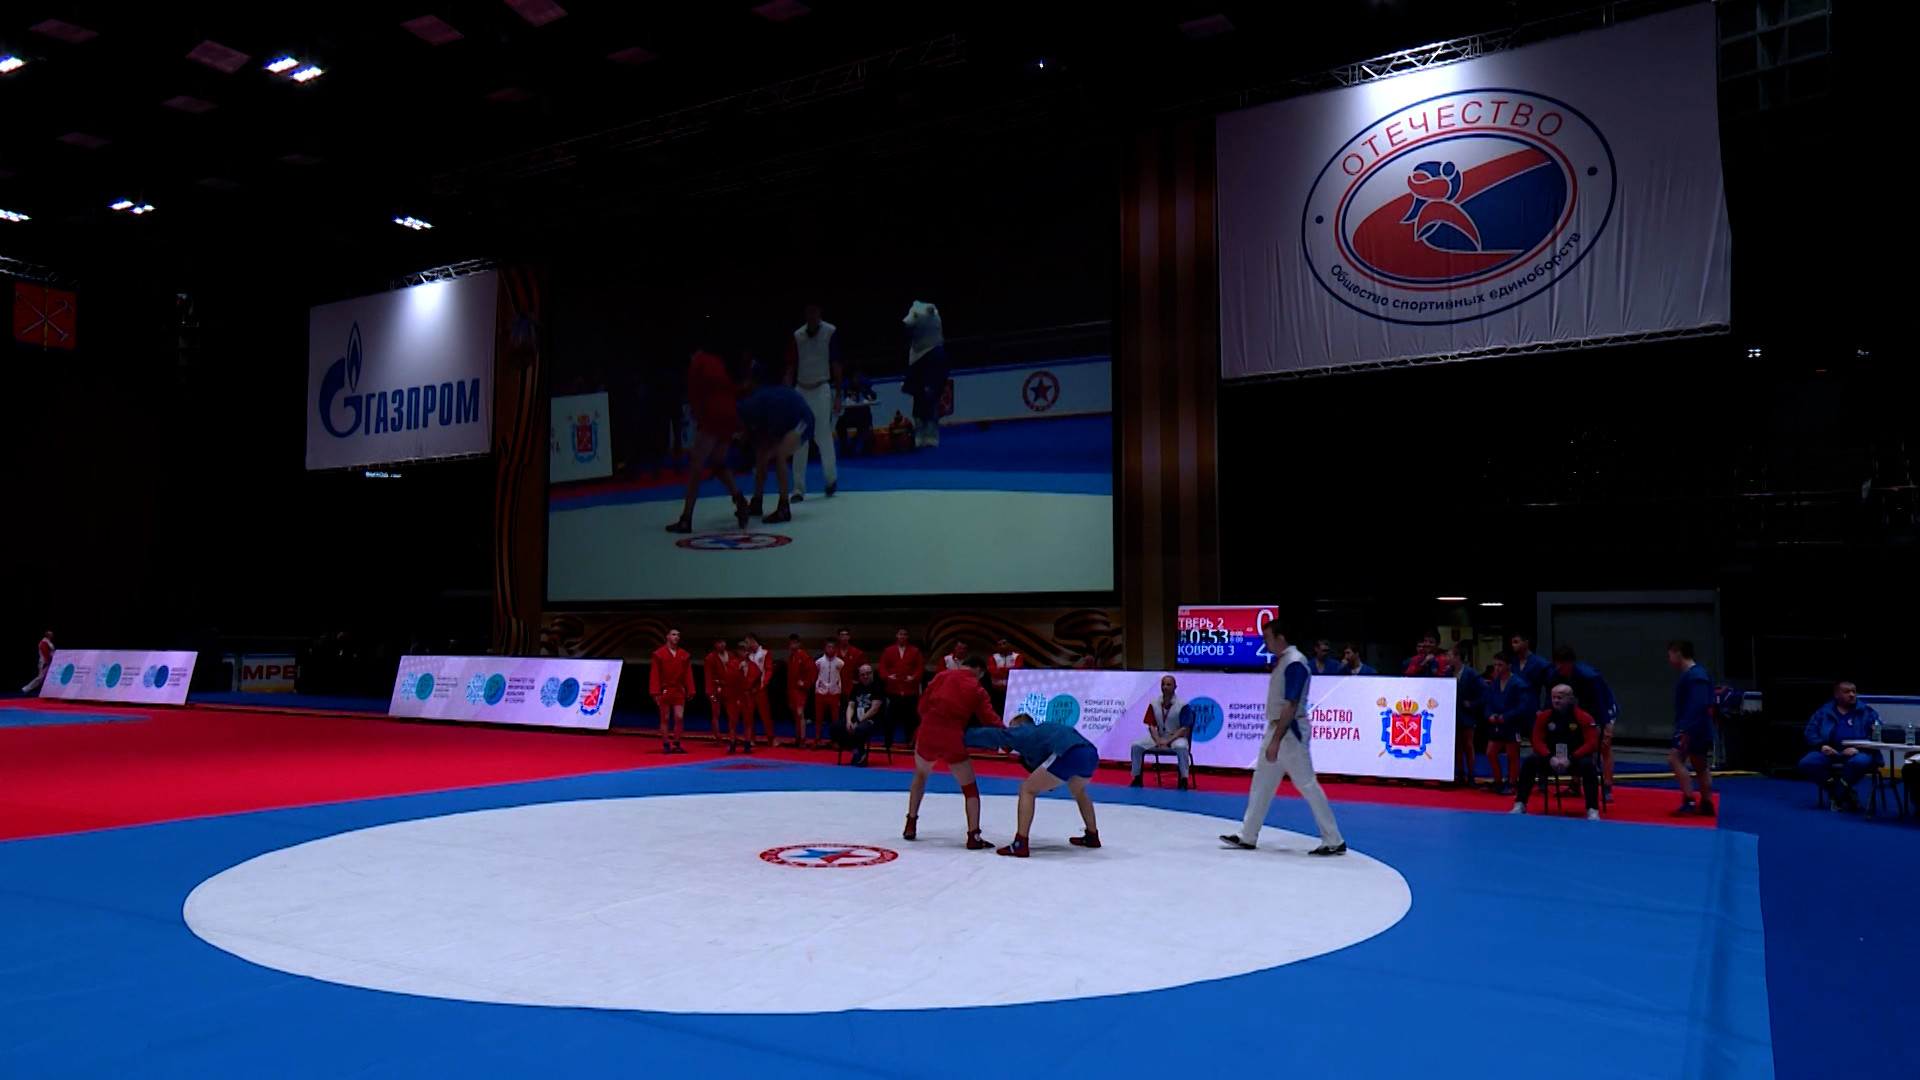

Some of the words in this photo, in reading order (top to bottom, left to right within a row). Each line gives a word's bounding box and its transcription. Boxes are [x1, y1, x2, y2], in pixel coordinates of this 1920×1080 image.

[1342, 100, 1563, 176] ОТЕЧЕСТВО
[1331, 264, 1389, 306] Общество
[1392, 291, 1485, 313] спортивных
[1489, 231, 1582, 300] единоборств
[364, 378, 480, 436] ГАЗПРОМ
[1178, 617, 1214, 630] ТВЕРЬ
[1217, 617, 1225, 630] 2
[1189, 629, 1229, 644] 0:53
[1311, 708, 1353, 723] ЛЬСТВО
